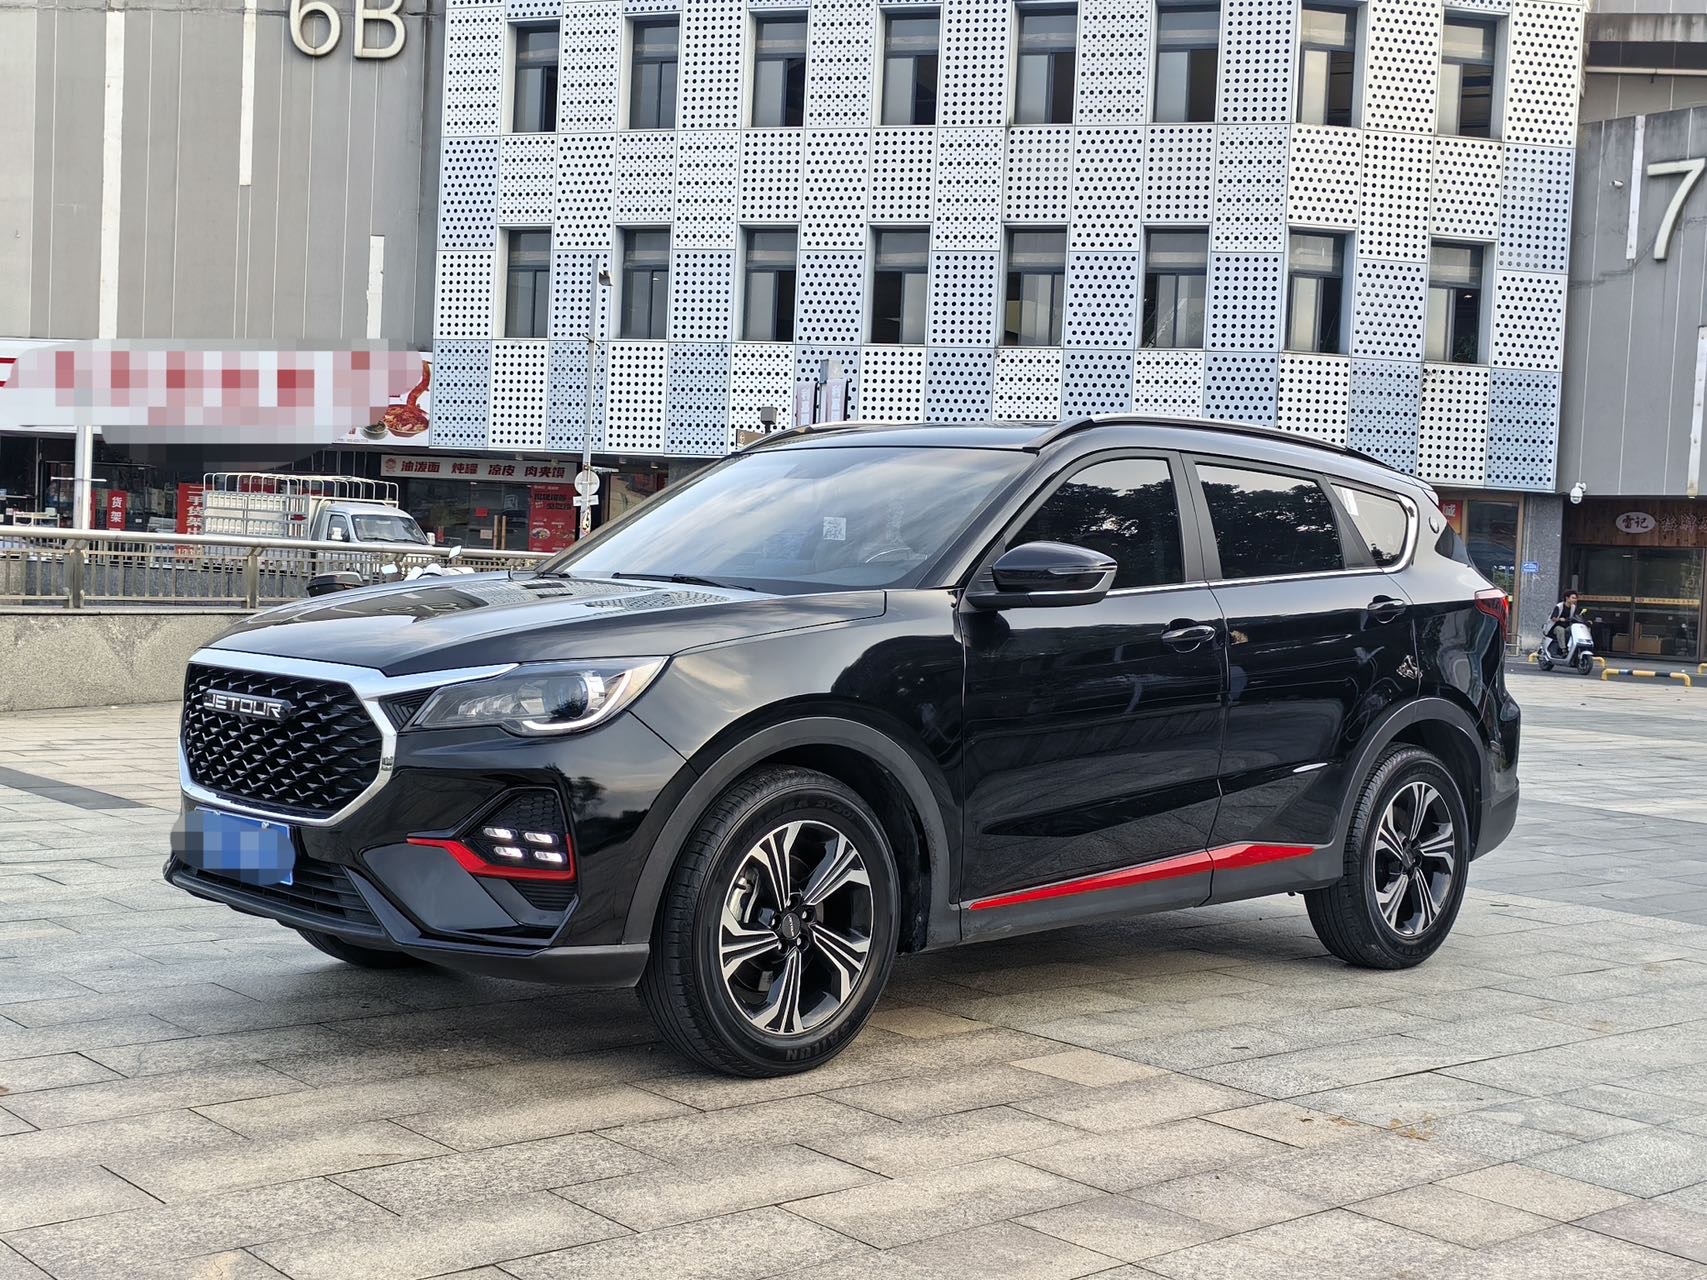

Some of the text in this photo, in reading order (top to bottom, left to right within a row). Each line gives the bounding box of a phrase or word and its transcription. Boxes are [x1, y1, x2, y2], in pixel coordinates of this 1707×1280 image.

[289, 0, 406, 58] 6B
[1647, 157, 1706, 260] 7
[401, 460, 440, 473] 油泼面
[488, 464, 515, 476] 凉皮
[524, 466, 566, 478] 肉夹馍
[110, 496, 122, 531] 货架
[203, 693, 282, 718] JETOUR
